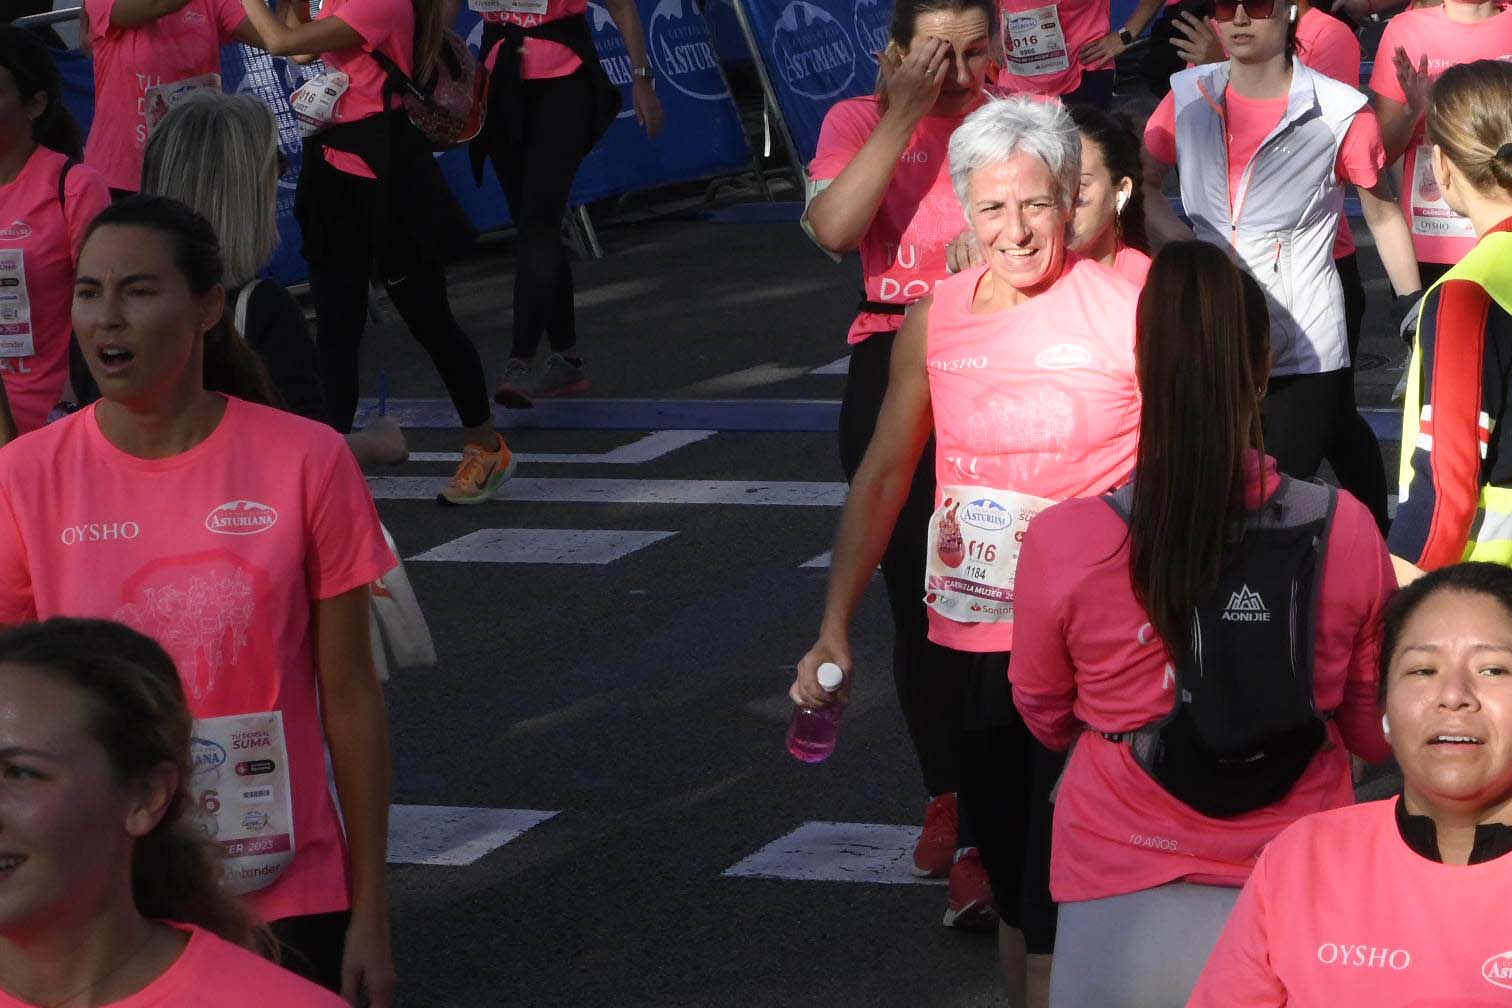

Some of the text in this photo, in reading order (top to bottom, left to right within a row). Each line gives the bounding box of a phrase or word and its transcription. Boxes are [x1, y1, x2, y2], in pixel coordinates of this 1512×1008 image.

[1013, 35, 1038, 48] 016
[211, 514, 273, 529] ASTURIANA
[61, 521, 140, 545] OYSHO
[974, 586, 1003, 600] MUJER
[1221, 610, 1271, 622] AONIJIE
[232, 737, 272, 750] SUMA
[1128, 833, 1179, 851] 10 AÑOS
[1317, 942, 1411, 971] OYSHO
